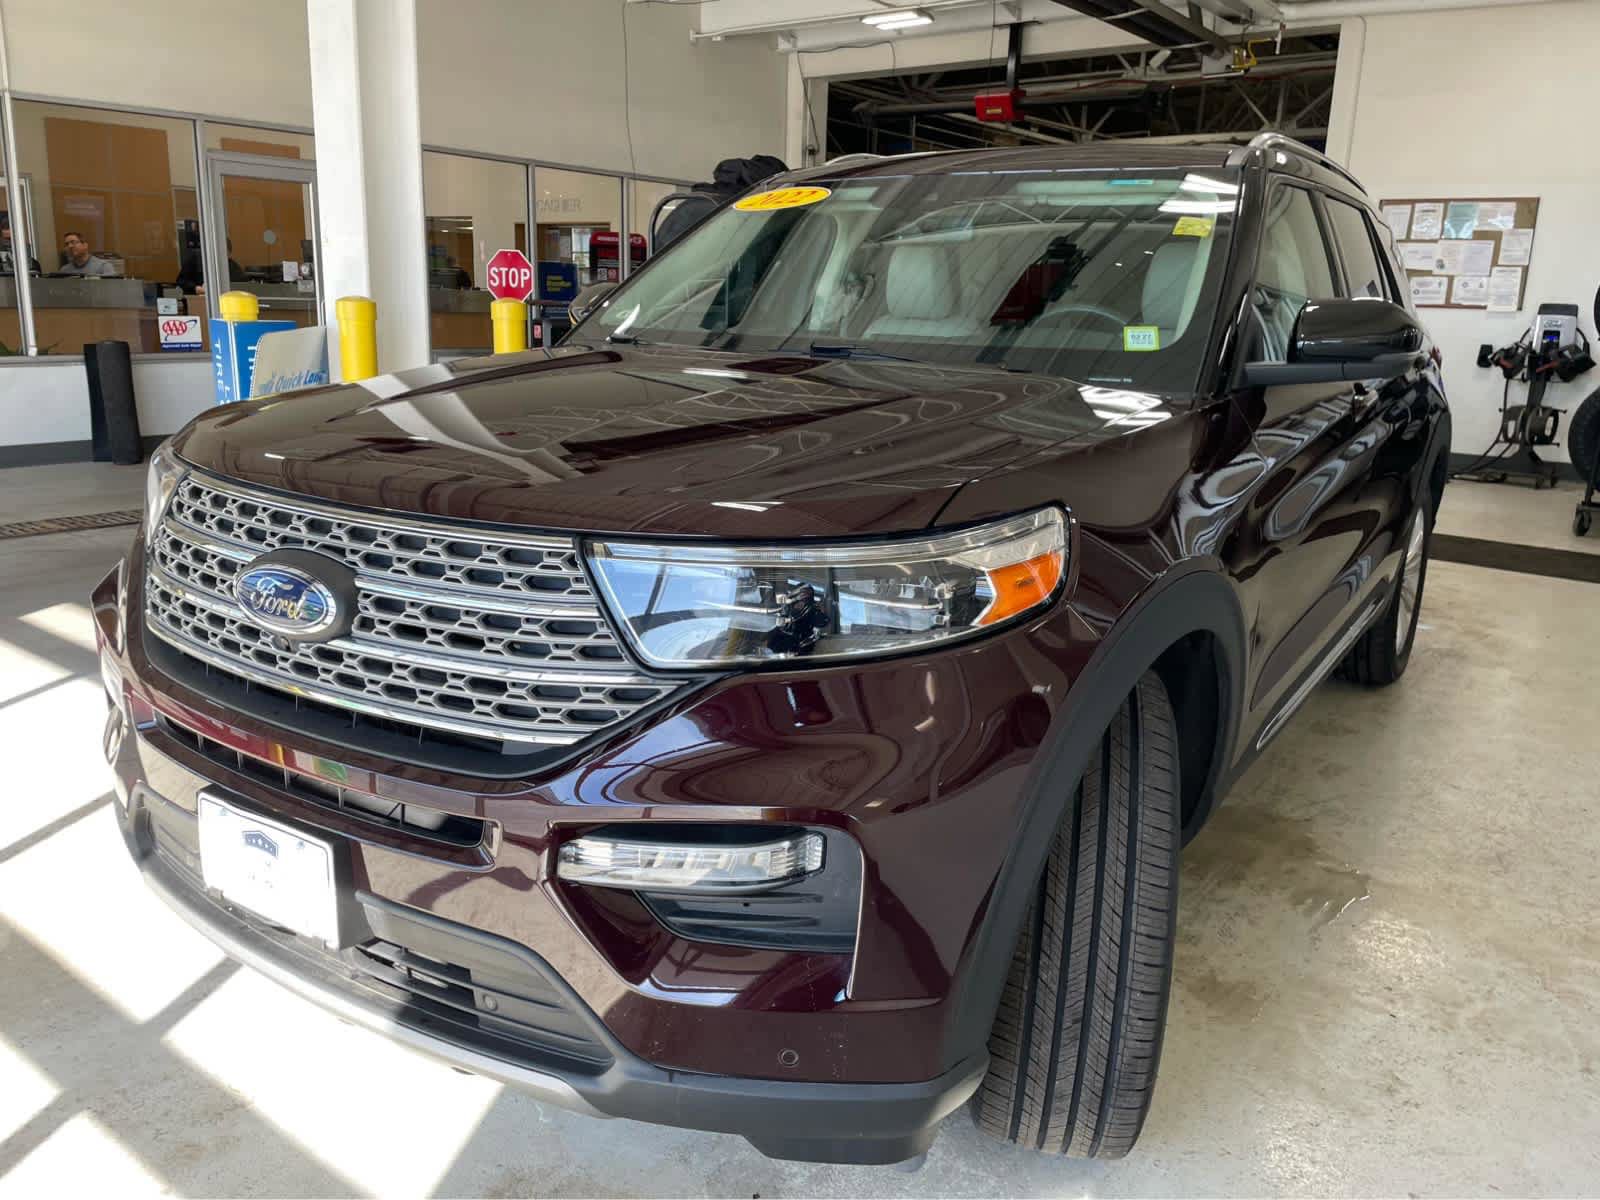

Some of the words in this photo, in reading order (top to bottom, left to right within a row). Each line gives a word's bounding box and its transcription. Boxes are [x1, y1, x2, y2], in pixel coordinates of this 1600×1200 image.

[489, 266, 531, 289] STOP
[163, 319, 187, 337] AAA
[214, 337, 225, 393] TIRE
[250, 576, 308, 621] Ford
